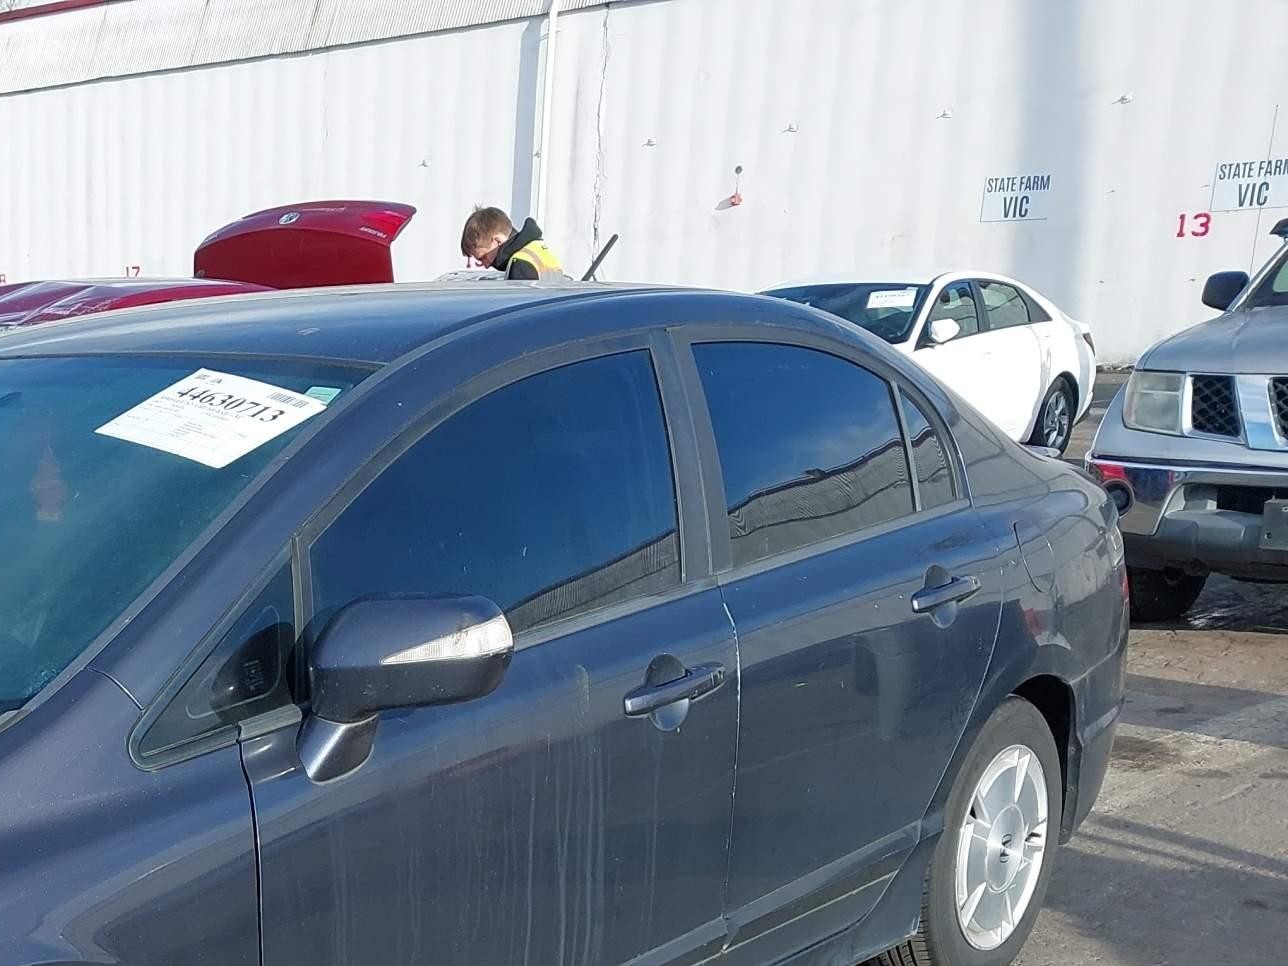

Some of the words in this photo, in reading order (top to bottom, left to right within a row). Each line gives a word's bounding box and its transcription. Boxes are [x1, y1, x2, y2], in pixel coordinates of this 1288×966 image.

[1218, 162, 1255, 180] STATE
[986, 177, 1017, 193] STATE
[1019, 175, 1051, 192] FARM
[1237, 181, 1270, 208] VIC
[1003, 195, 1030, 218] VIC
[1176, 212, 1212, 238] 13
[177, 385, 286, 422] 44630713
